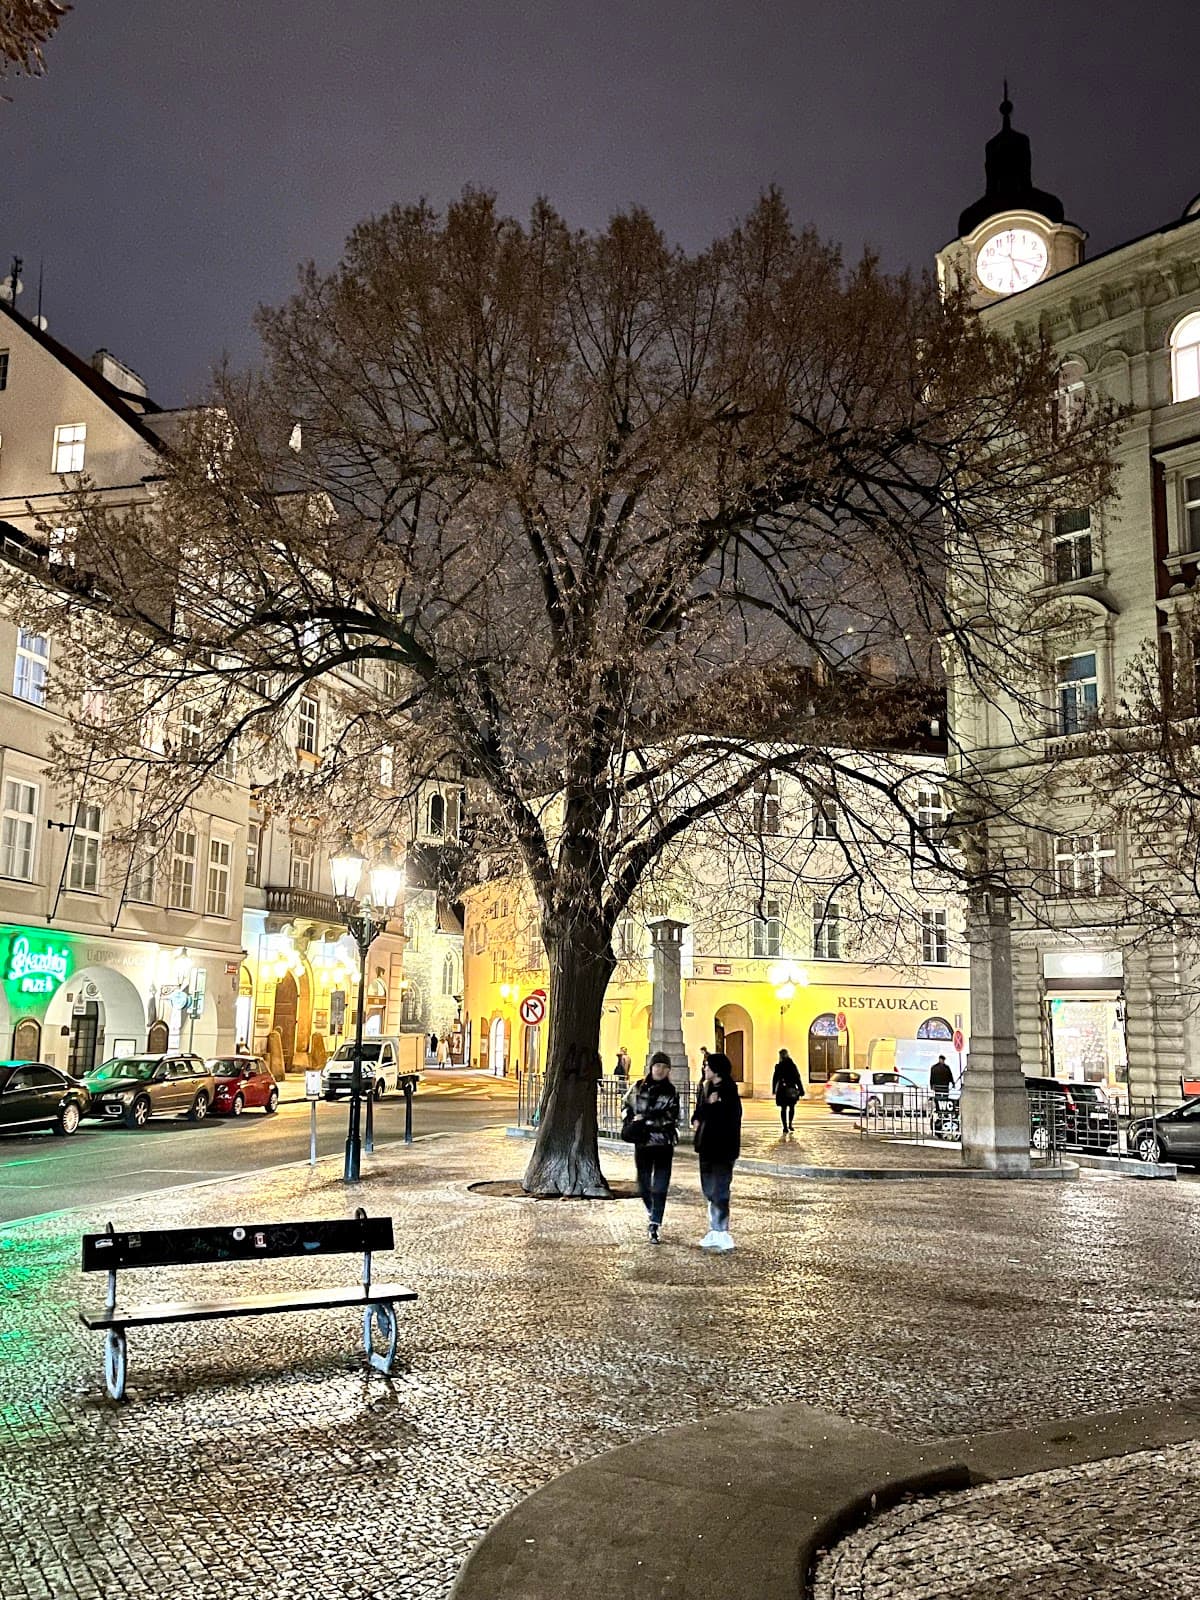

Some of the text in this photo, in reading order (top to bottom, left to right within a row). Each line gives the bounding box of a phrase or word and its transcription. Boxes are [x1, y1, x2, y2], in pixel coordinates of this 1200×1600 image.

[1006, 233, 1016, 243] 12
[996, 239, 1002, 248] 11
[1031, 241, 1037, 250] 2
[986, 247, 996, 257] 10
[837, 996, 939, 1011] RESTAURACE
[937, 1100, 954, 1112] WC
